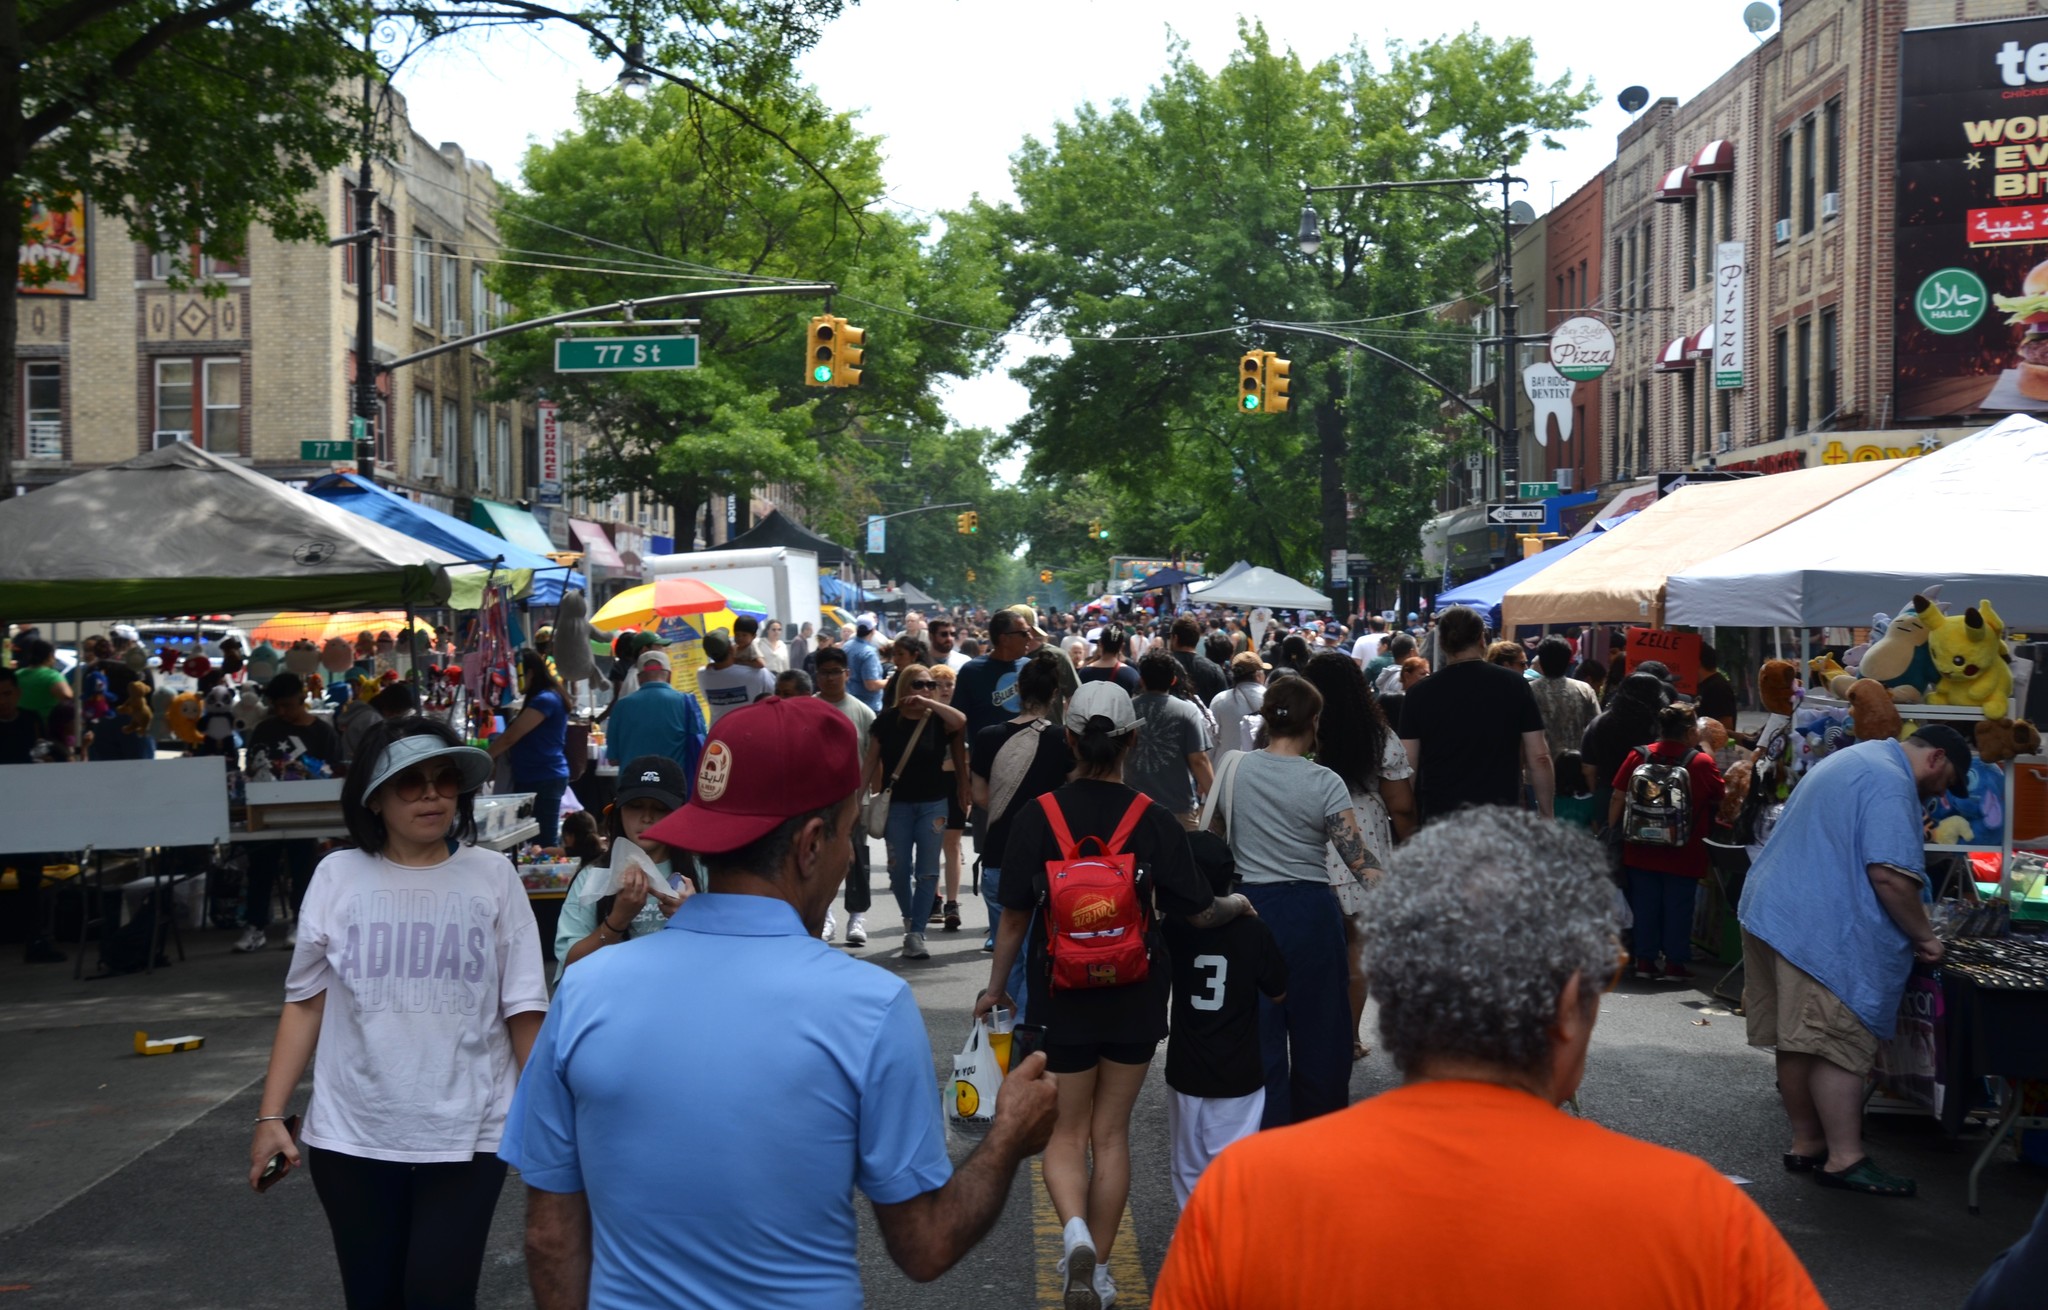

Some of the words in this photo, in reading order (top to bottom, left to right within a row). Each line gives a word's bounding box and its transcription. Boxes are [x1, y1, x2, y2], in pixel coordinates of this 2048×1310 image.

[1922, 281, 1980, 310] حلال
[1720, 264, 1742, 367] Pizza
[1931, 310, 1971, 319] HALAL
[594, 345, 624, 364] 77
[632, 344, 661, 363] St
[1554, 343, 1611, 364] Pizza
[1532, 376, 1546, 387] BAY
[1547, 376, 1570, 387] RIDGE
[1532, 388, 1570, 399] DENTIST
[314, 442, 330, 458] 77
[544, 410, 556, 479] INSURANCE
[1528, 484, 1540, 496] 77
[1497, 510, 1513, 519] ONE
[1521, 510, 1538, 518] WAY
[1636, 632, 1681, 650] ZELLE
[992, 686, 1015, 705] BLUE
[340, 922, 485, 983] ADIDAS
[1191, 954, 1228, 1011] 3
[962, 1065, 976, 1077] YOU
